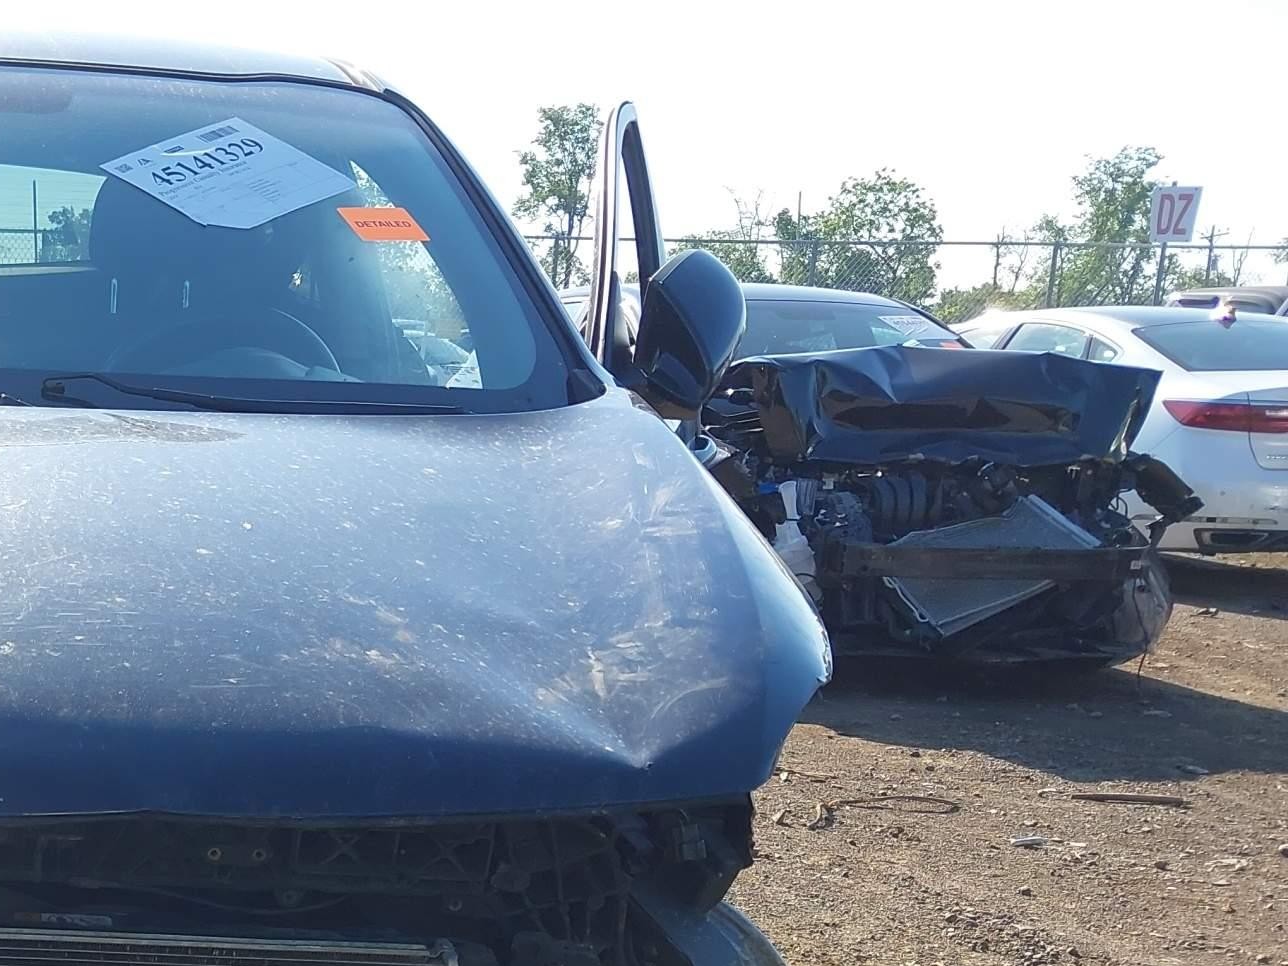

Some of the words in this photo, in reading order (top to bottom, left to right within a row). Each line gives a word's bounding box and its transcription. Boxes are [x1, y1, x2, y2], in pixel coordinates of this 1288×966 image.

[151, 138, 264, 186] 45141329
[354, 220, 412, 228] DETAILED
[1156, 193, 1194, 235] DZ
